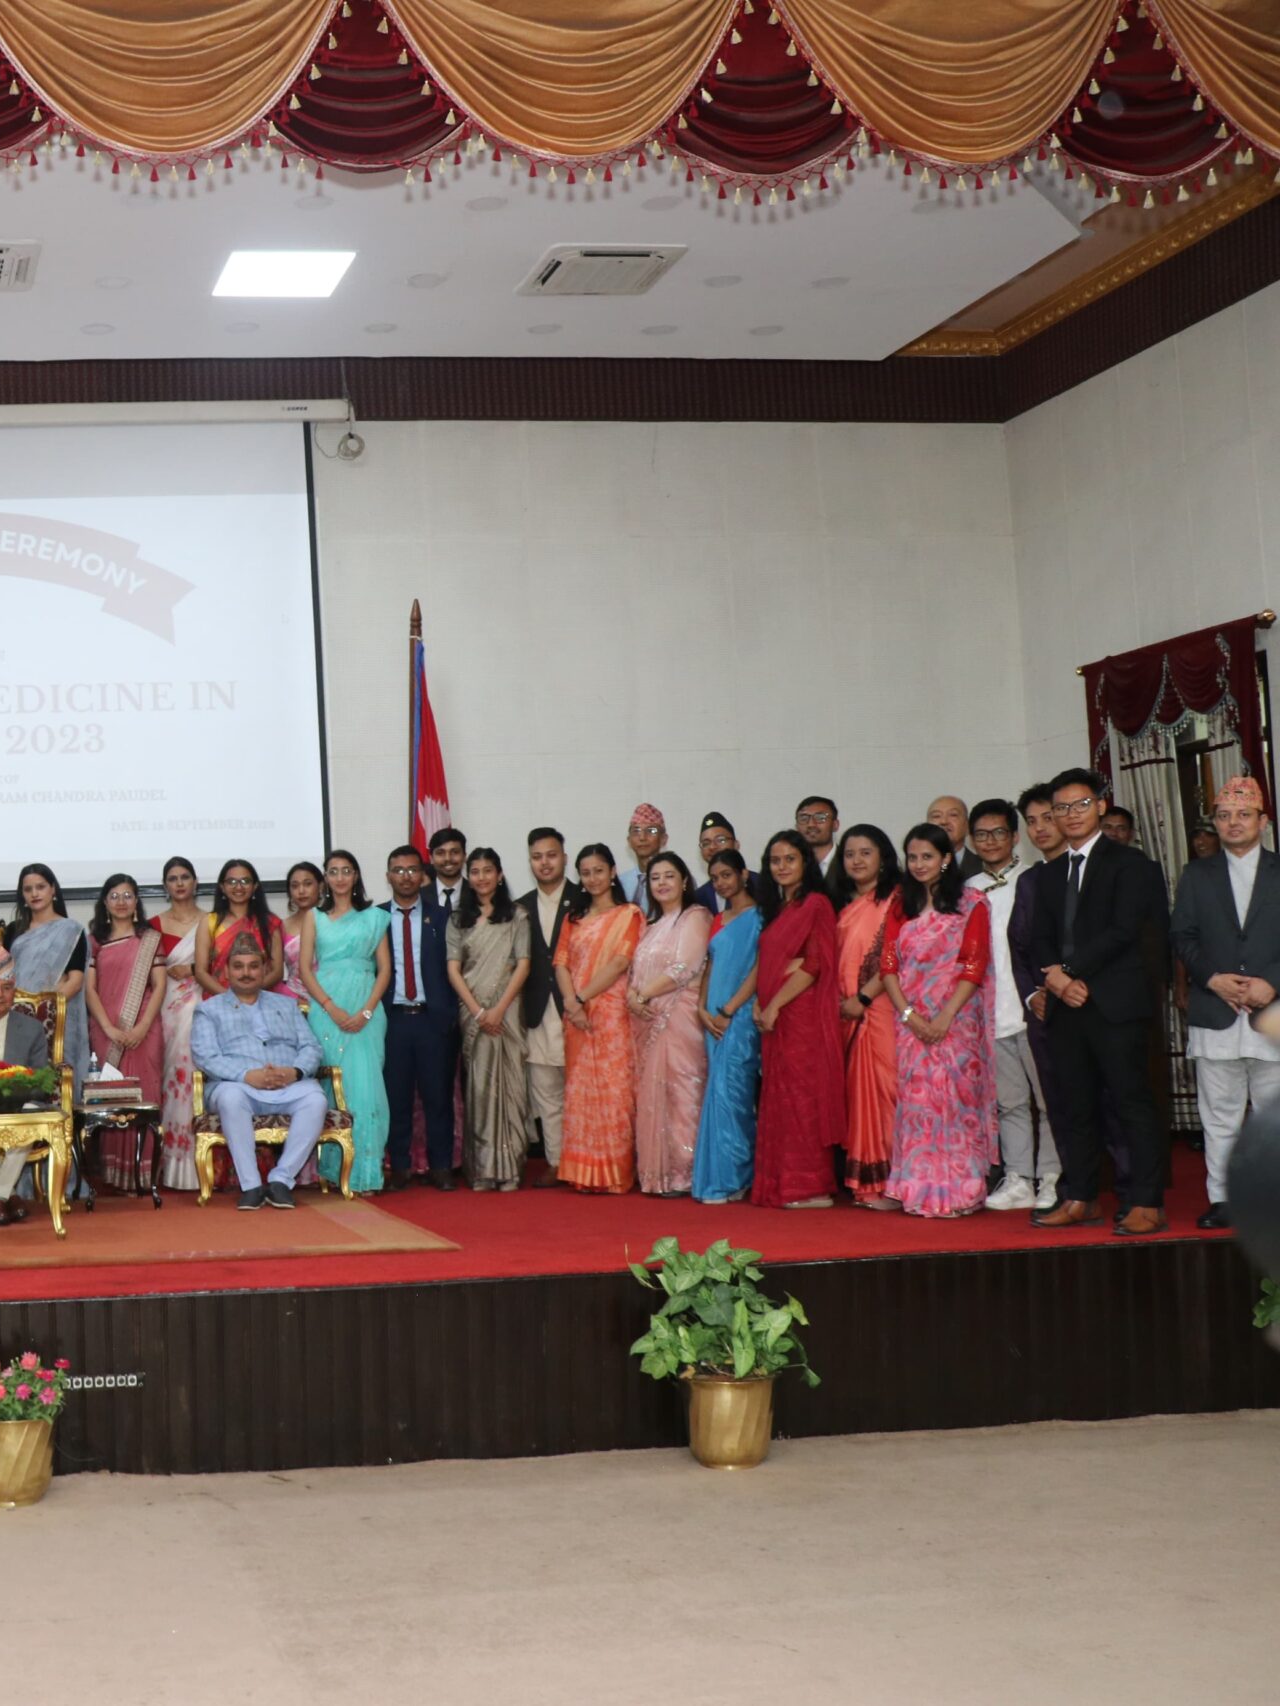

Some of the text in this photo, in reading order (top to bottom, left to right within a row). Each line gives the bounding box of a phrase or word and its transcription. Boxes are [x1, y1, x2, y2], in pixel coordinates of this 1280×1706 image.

[189, 680, 238, 711] IN
[5, 723, 106, 755] 2023
[31, 790, 105, 803] CHANDRA
[109, 788, 168, 802] PAUDEL
